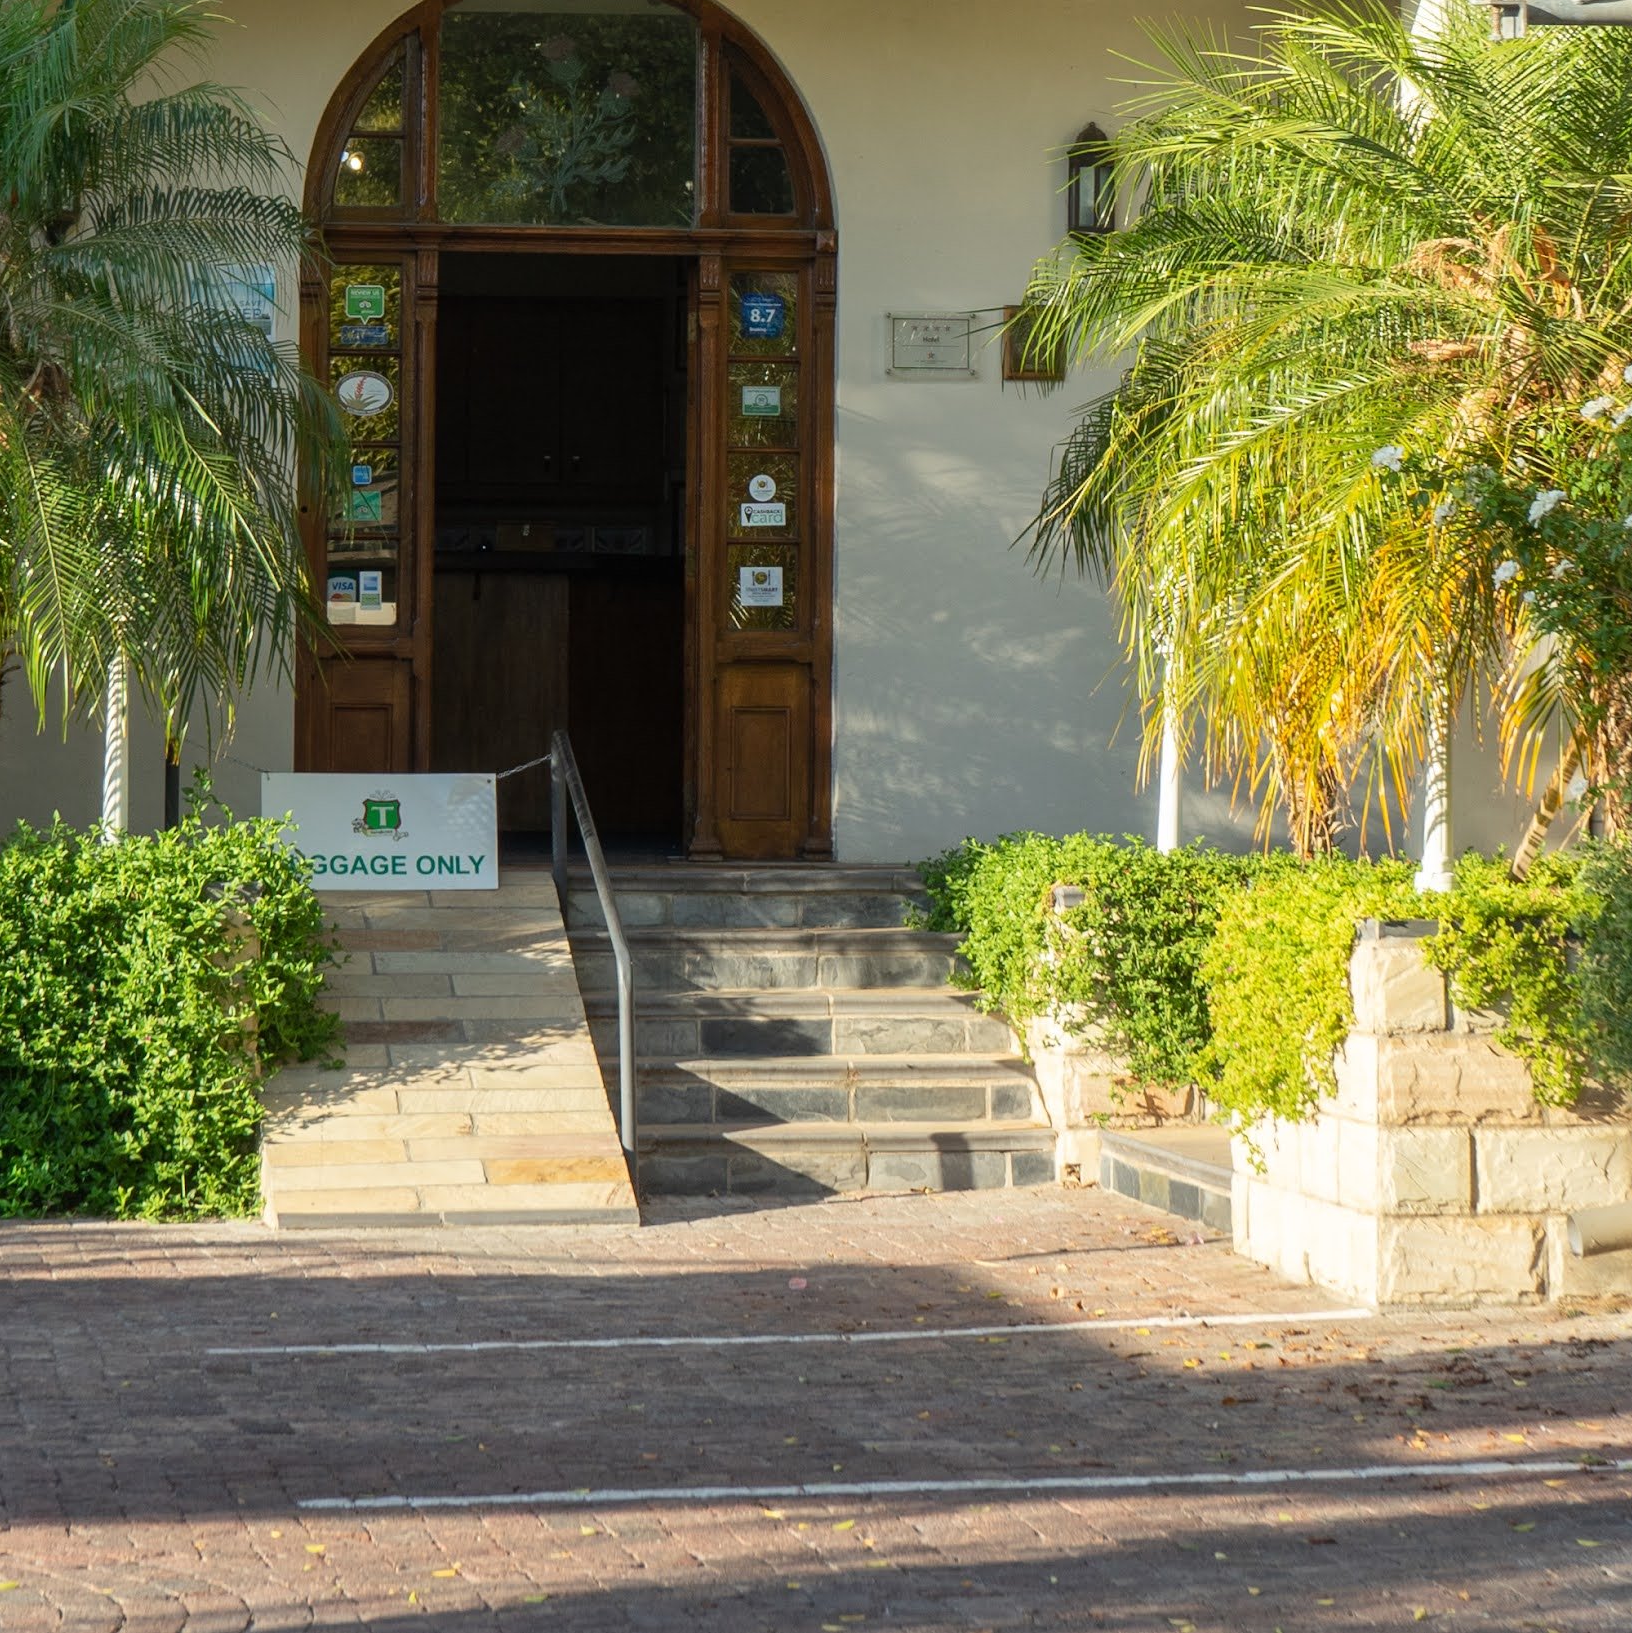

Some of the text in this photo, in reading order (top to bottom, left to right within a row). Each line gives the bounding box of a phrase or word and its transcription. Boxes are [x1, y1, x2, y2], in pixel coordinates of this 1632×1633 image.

[750, 308, 776, 323] 8.7
[332, 581, 354, 591] VISA
[309, 854, 486, 875] GGAGE ONLY
